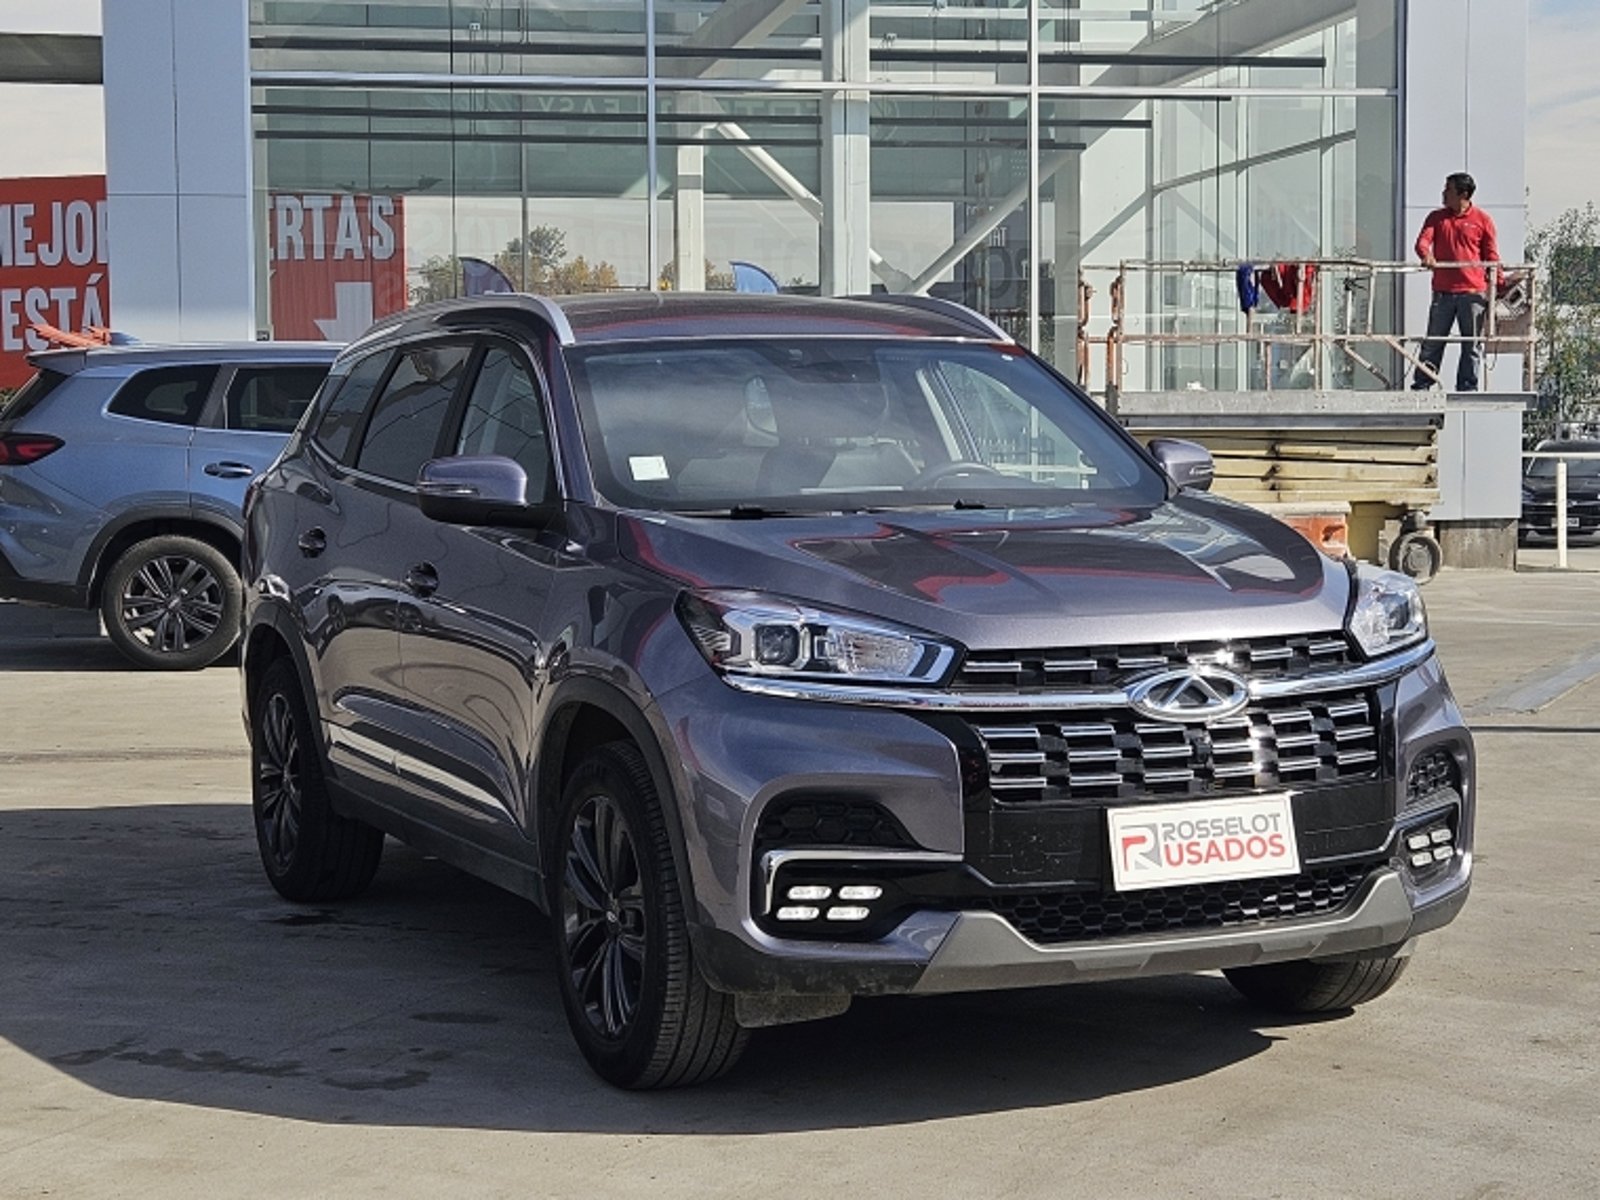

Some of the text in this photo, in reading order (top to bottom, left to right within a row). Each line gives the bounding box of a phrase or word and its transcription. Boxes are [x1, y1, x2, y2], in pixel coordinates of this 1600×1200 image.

[269, 195, 395, 260] RTAS
[2, 273, 105, 350] ESTÁ
[1161, 813, 1281, 842] ROSSELOT
[1164, 834, 1286, 867] USADOS
